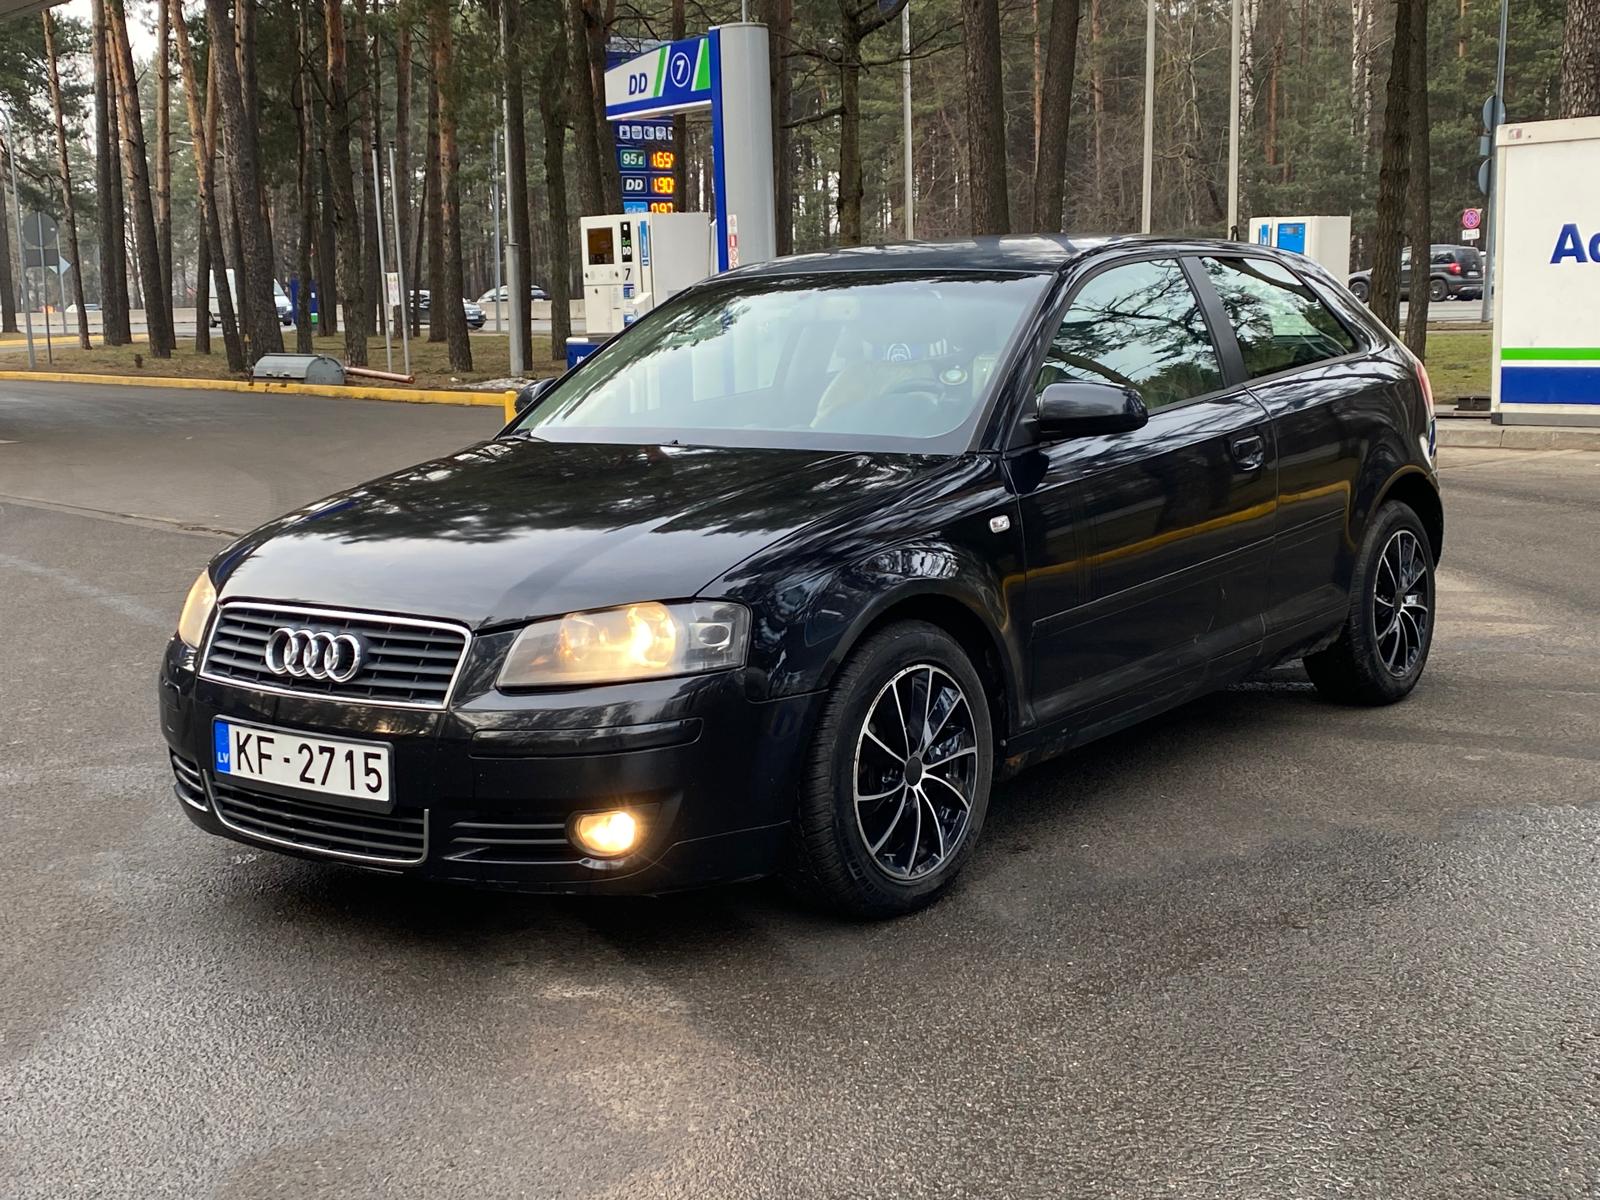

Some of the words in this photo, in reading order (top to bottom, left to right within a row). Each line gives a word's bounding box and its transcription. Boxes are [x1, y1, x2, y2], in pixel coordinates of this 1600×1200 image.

[676, 59, 685, 81] 7
[628, 72, 648, 96] DD
[625, 179, 644, 191] DD
[625, 266, 631, 281] 7
[217, 751, 230, 764] LV
